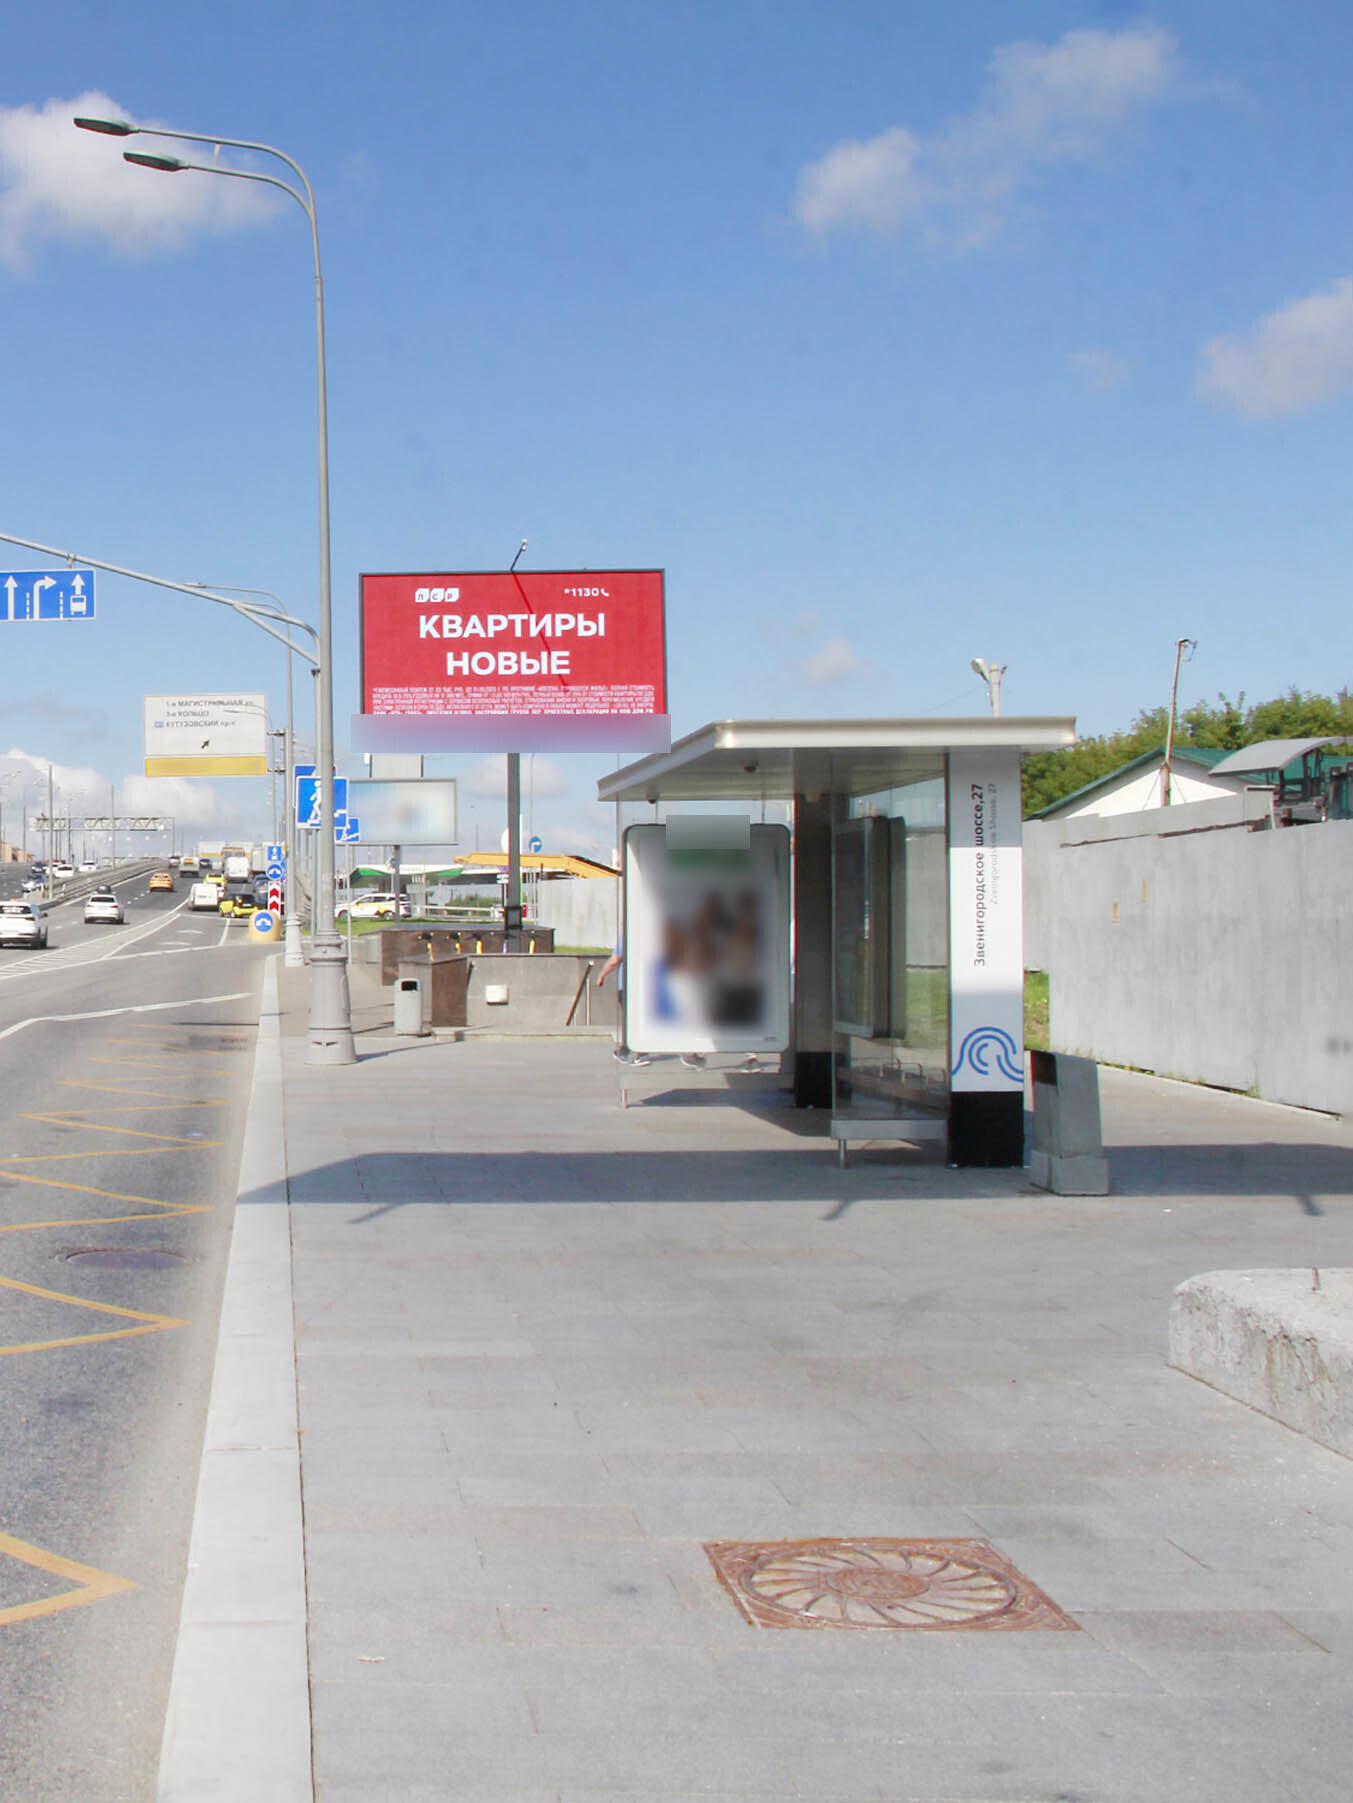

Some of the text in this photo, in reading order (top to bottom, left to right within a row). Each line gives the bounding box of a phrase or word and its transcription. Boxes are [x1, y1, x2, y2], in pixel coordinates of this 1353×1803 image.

[419, 613, 606, 639] КВАРТИРЫ
[446, 651, 571, 676] НОВЫЕ
[973, 853, 987, 967] Звенигородское
